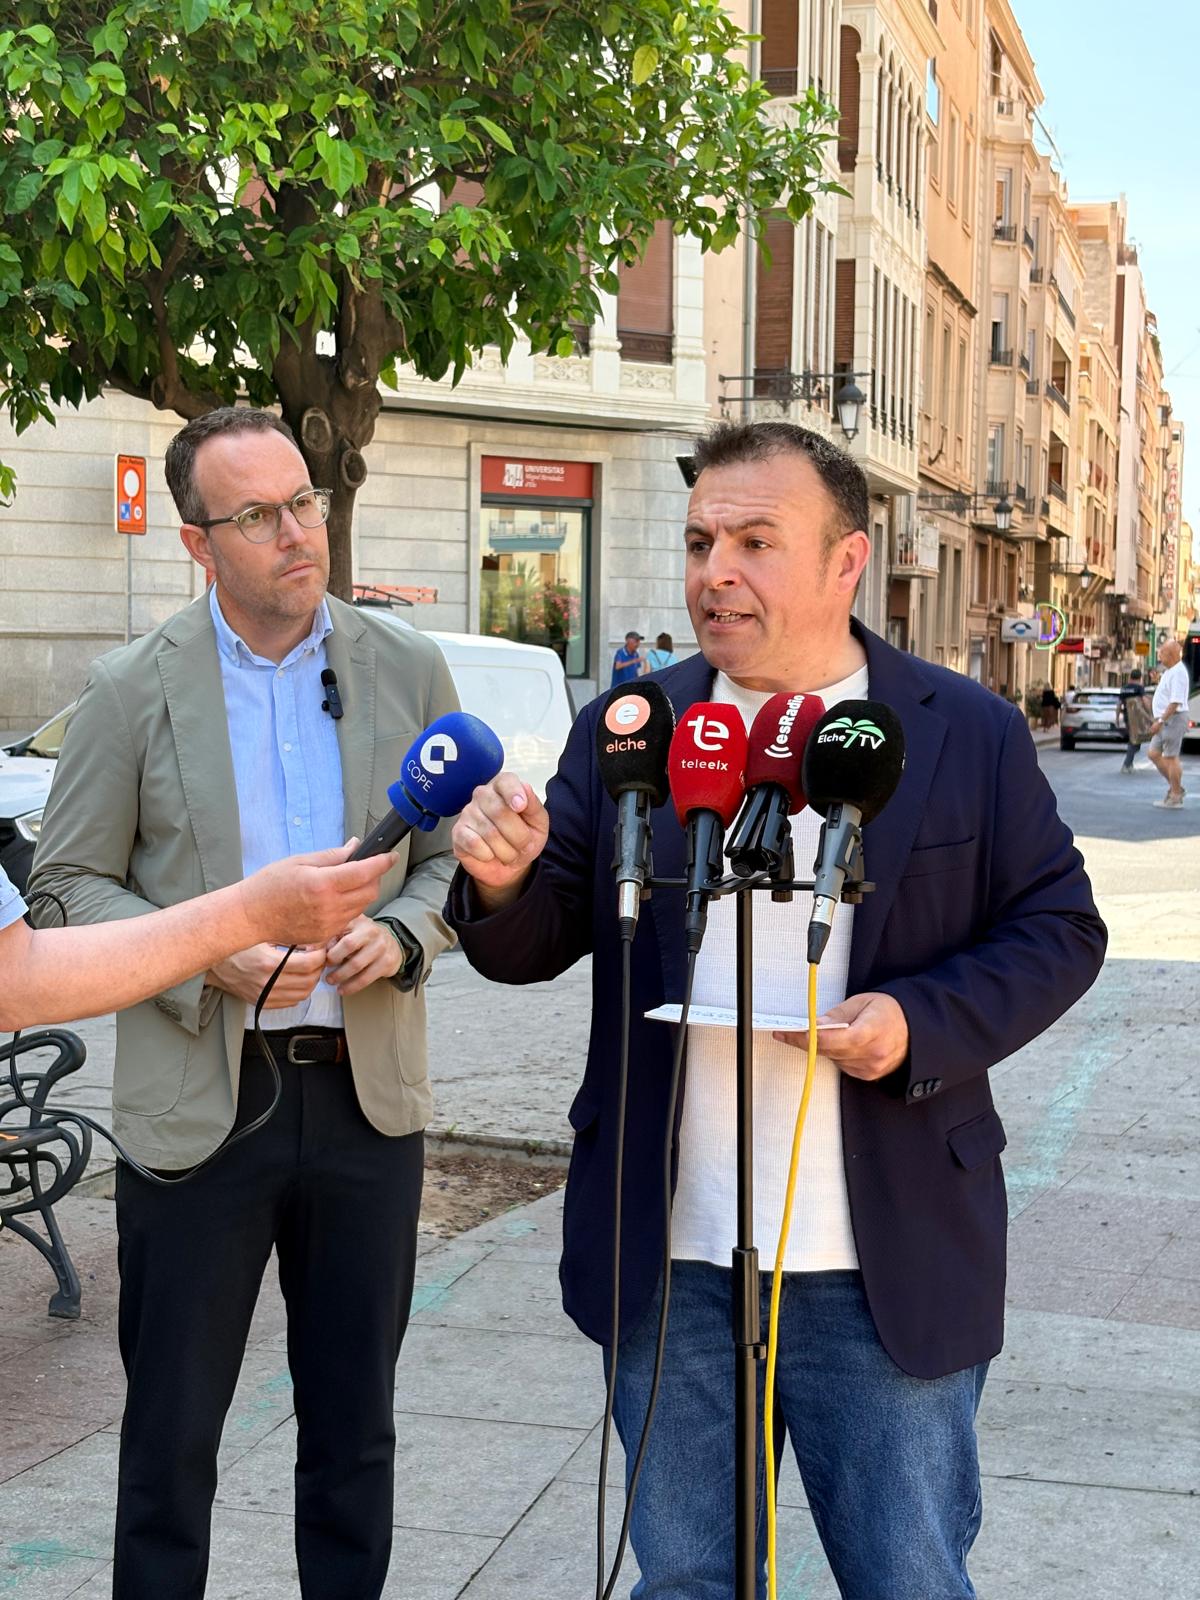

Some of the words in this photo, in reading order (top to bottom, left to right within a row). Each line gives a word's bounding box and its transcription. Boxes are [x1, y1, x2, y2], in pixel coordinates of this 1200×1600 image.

[524, 465, 565, 474] UNIVERSITAS
[776, 694, 806, 745] esRadio
[605, 737, 647, 754] elche
[681, 759, 729, 771] teleelx
[406, 759, 434, 793] COPE
